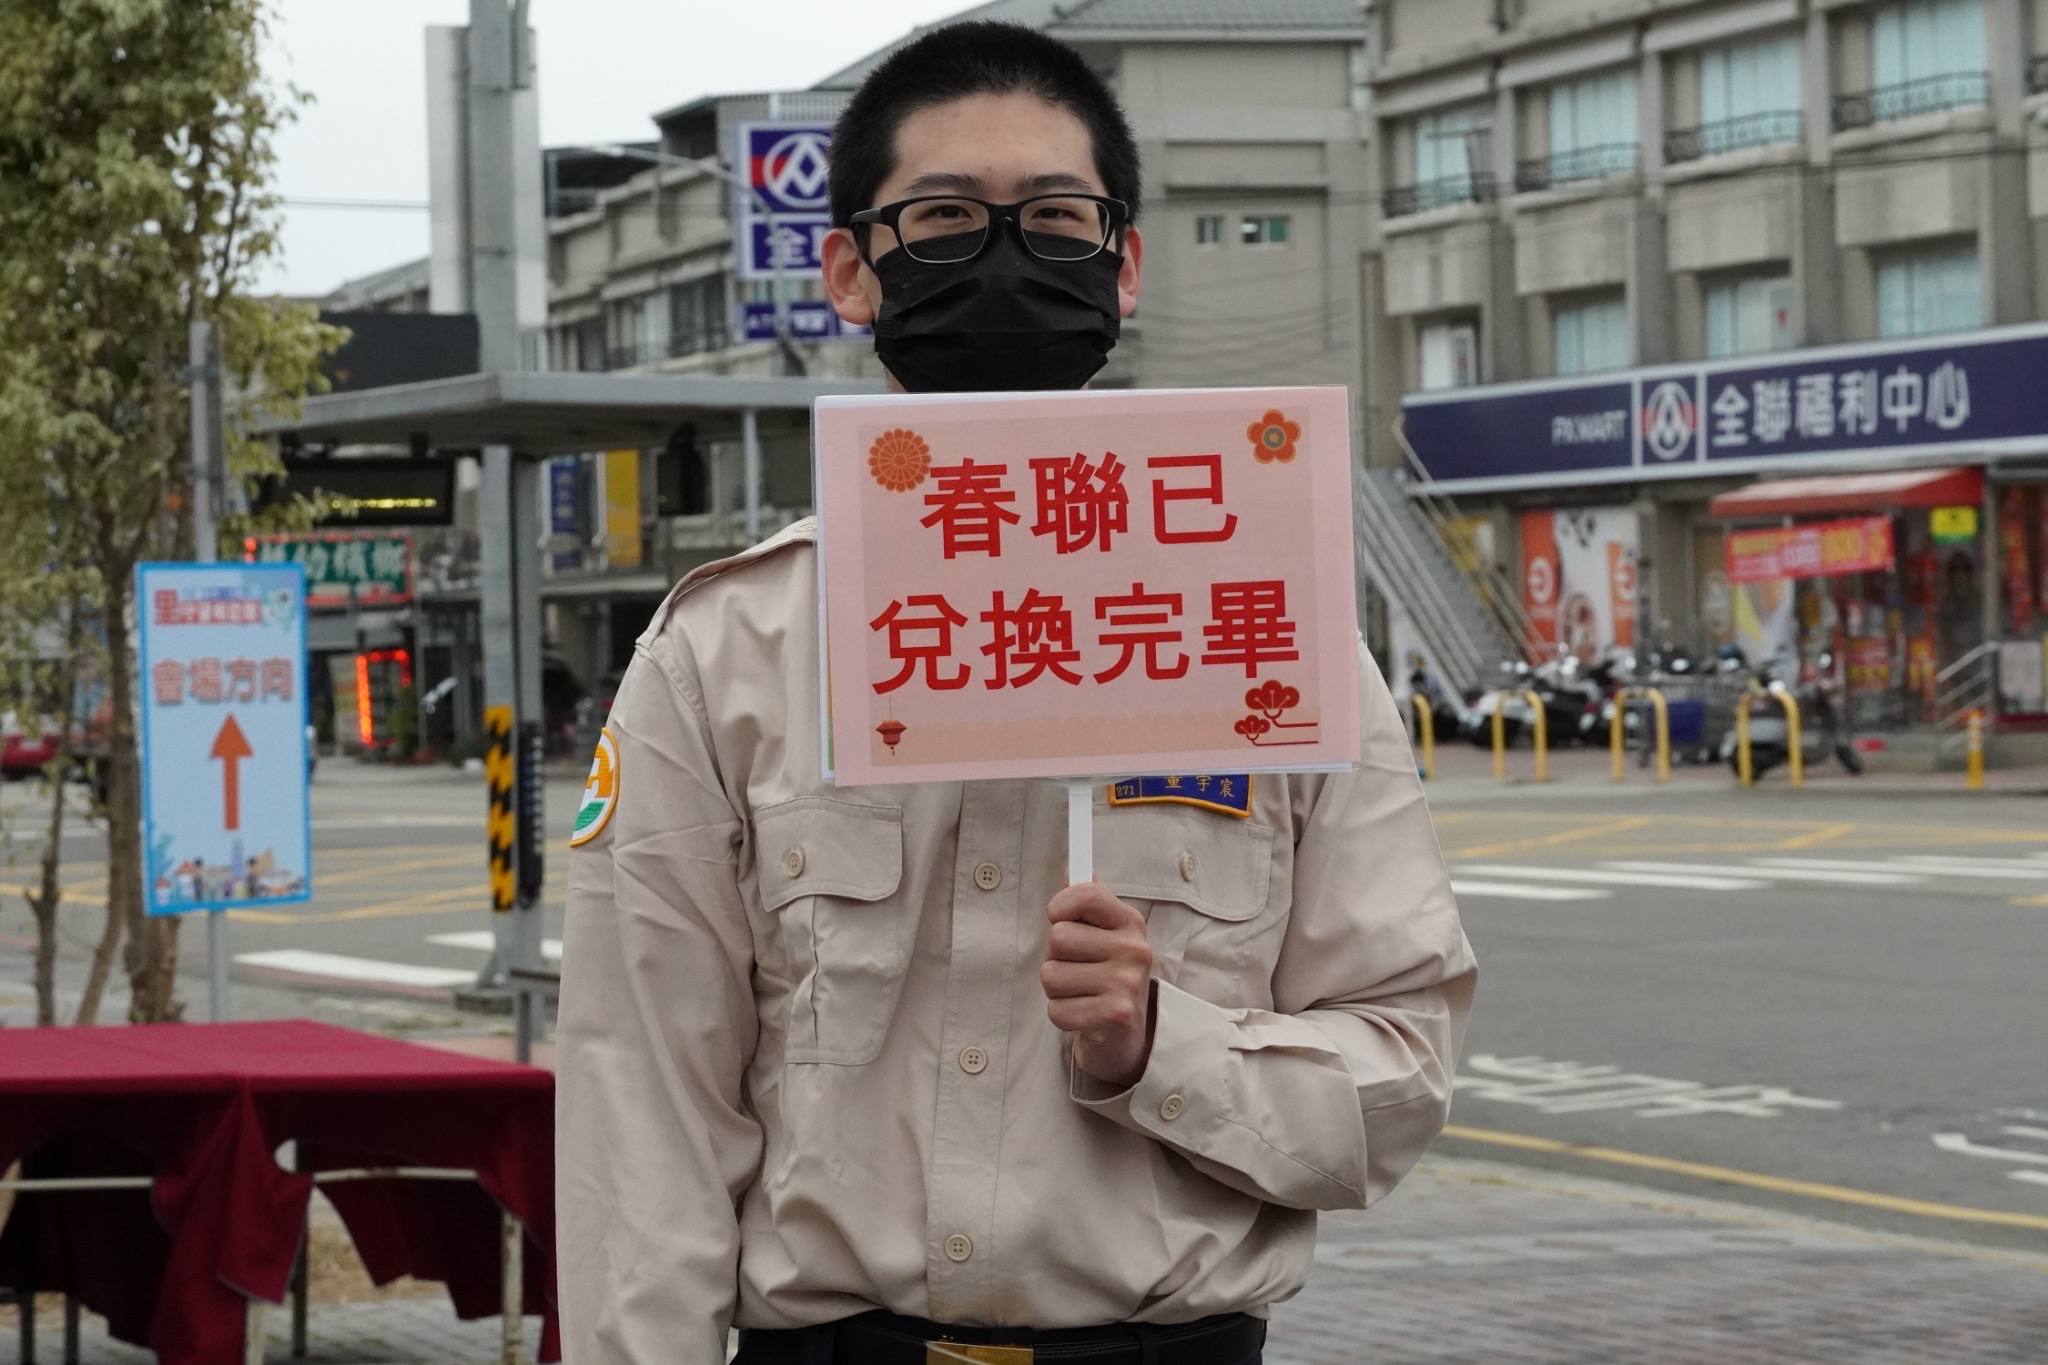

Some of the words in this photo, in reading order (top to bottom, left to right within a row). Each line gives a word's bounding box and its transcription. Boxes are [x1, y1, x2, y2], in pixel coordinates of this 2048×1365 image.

[1711, 361, 1971, 449] 全聯福利中心
[919, 451, 1238, 560] 春聯已
[154, 656, 294, 706] 會場方向
[868, 579, 1300, 695] 兌換完畢
